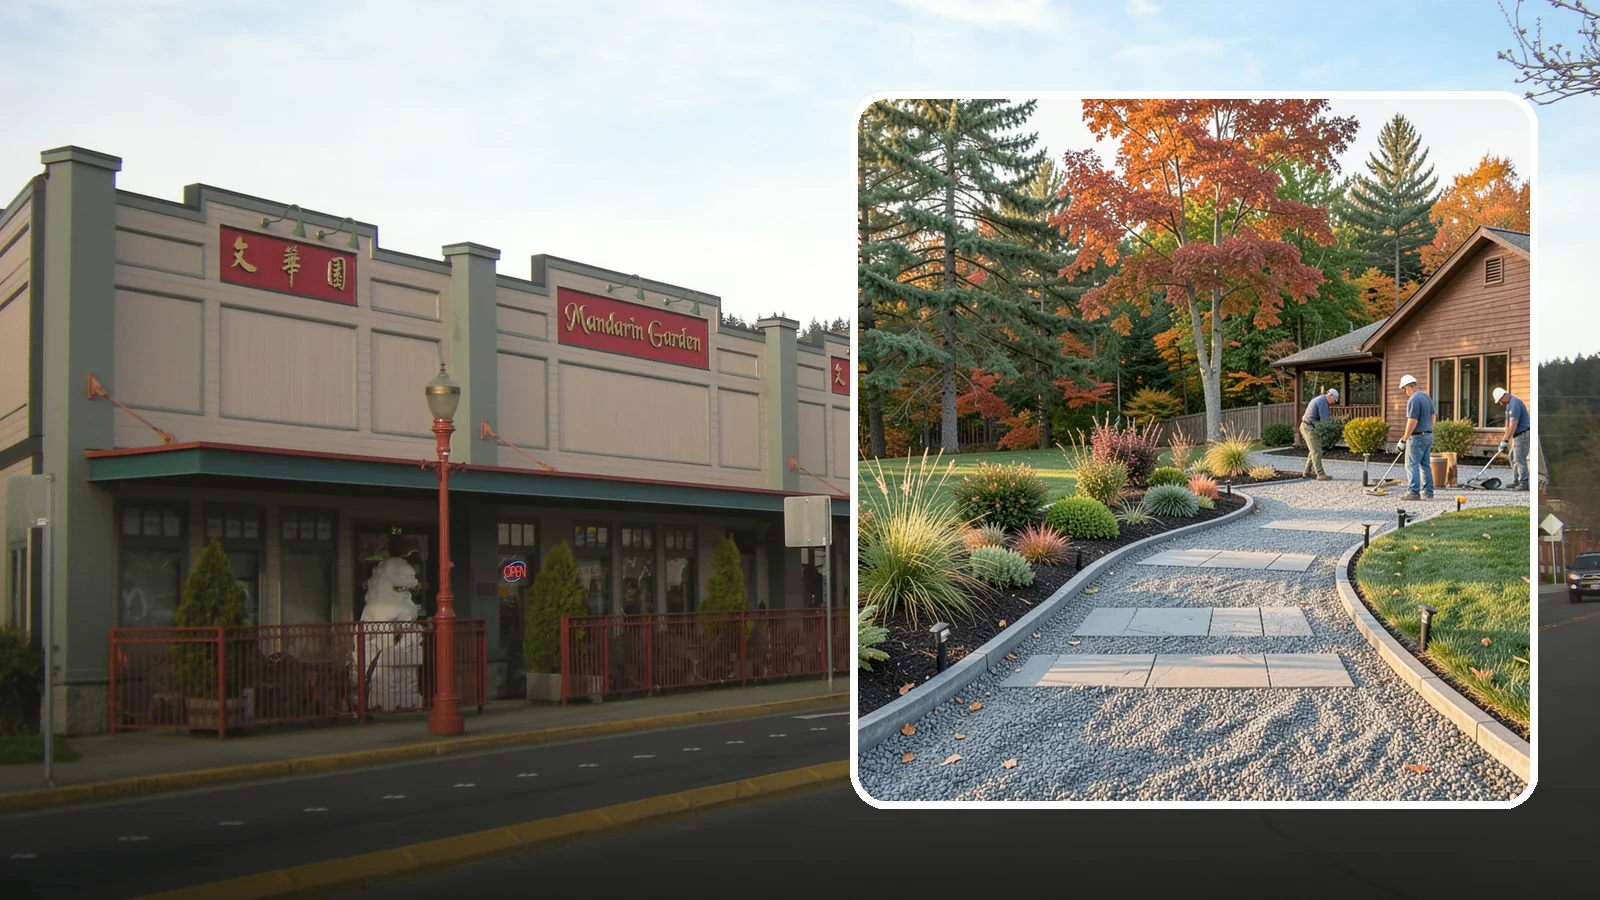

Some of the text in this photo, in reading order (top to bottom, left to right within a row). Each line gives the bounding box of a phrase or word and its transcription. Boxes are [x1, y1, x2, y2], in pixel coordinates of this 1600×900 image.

[231, 235, 346, 291] 文華園
[564, 302, 701, 352] Mandarin Garden
[503, 565, 527, 579] OPEN
